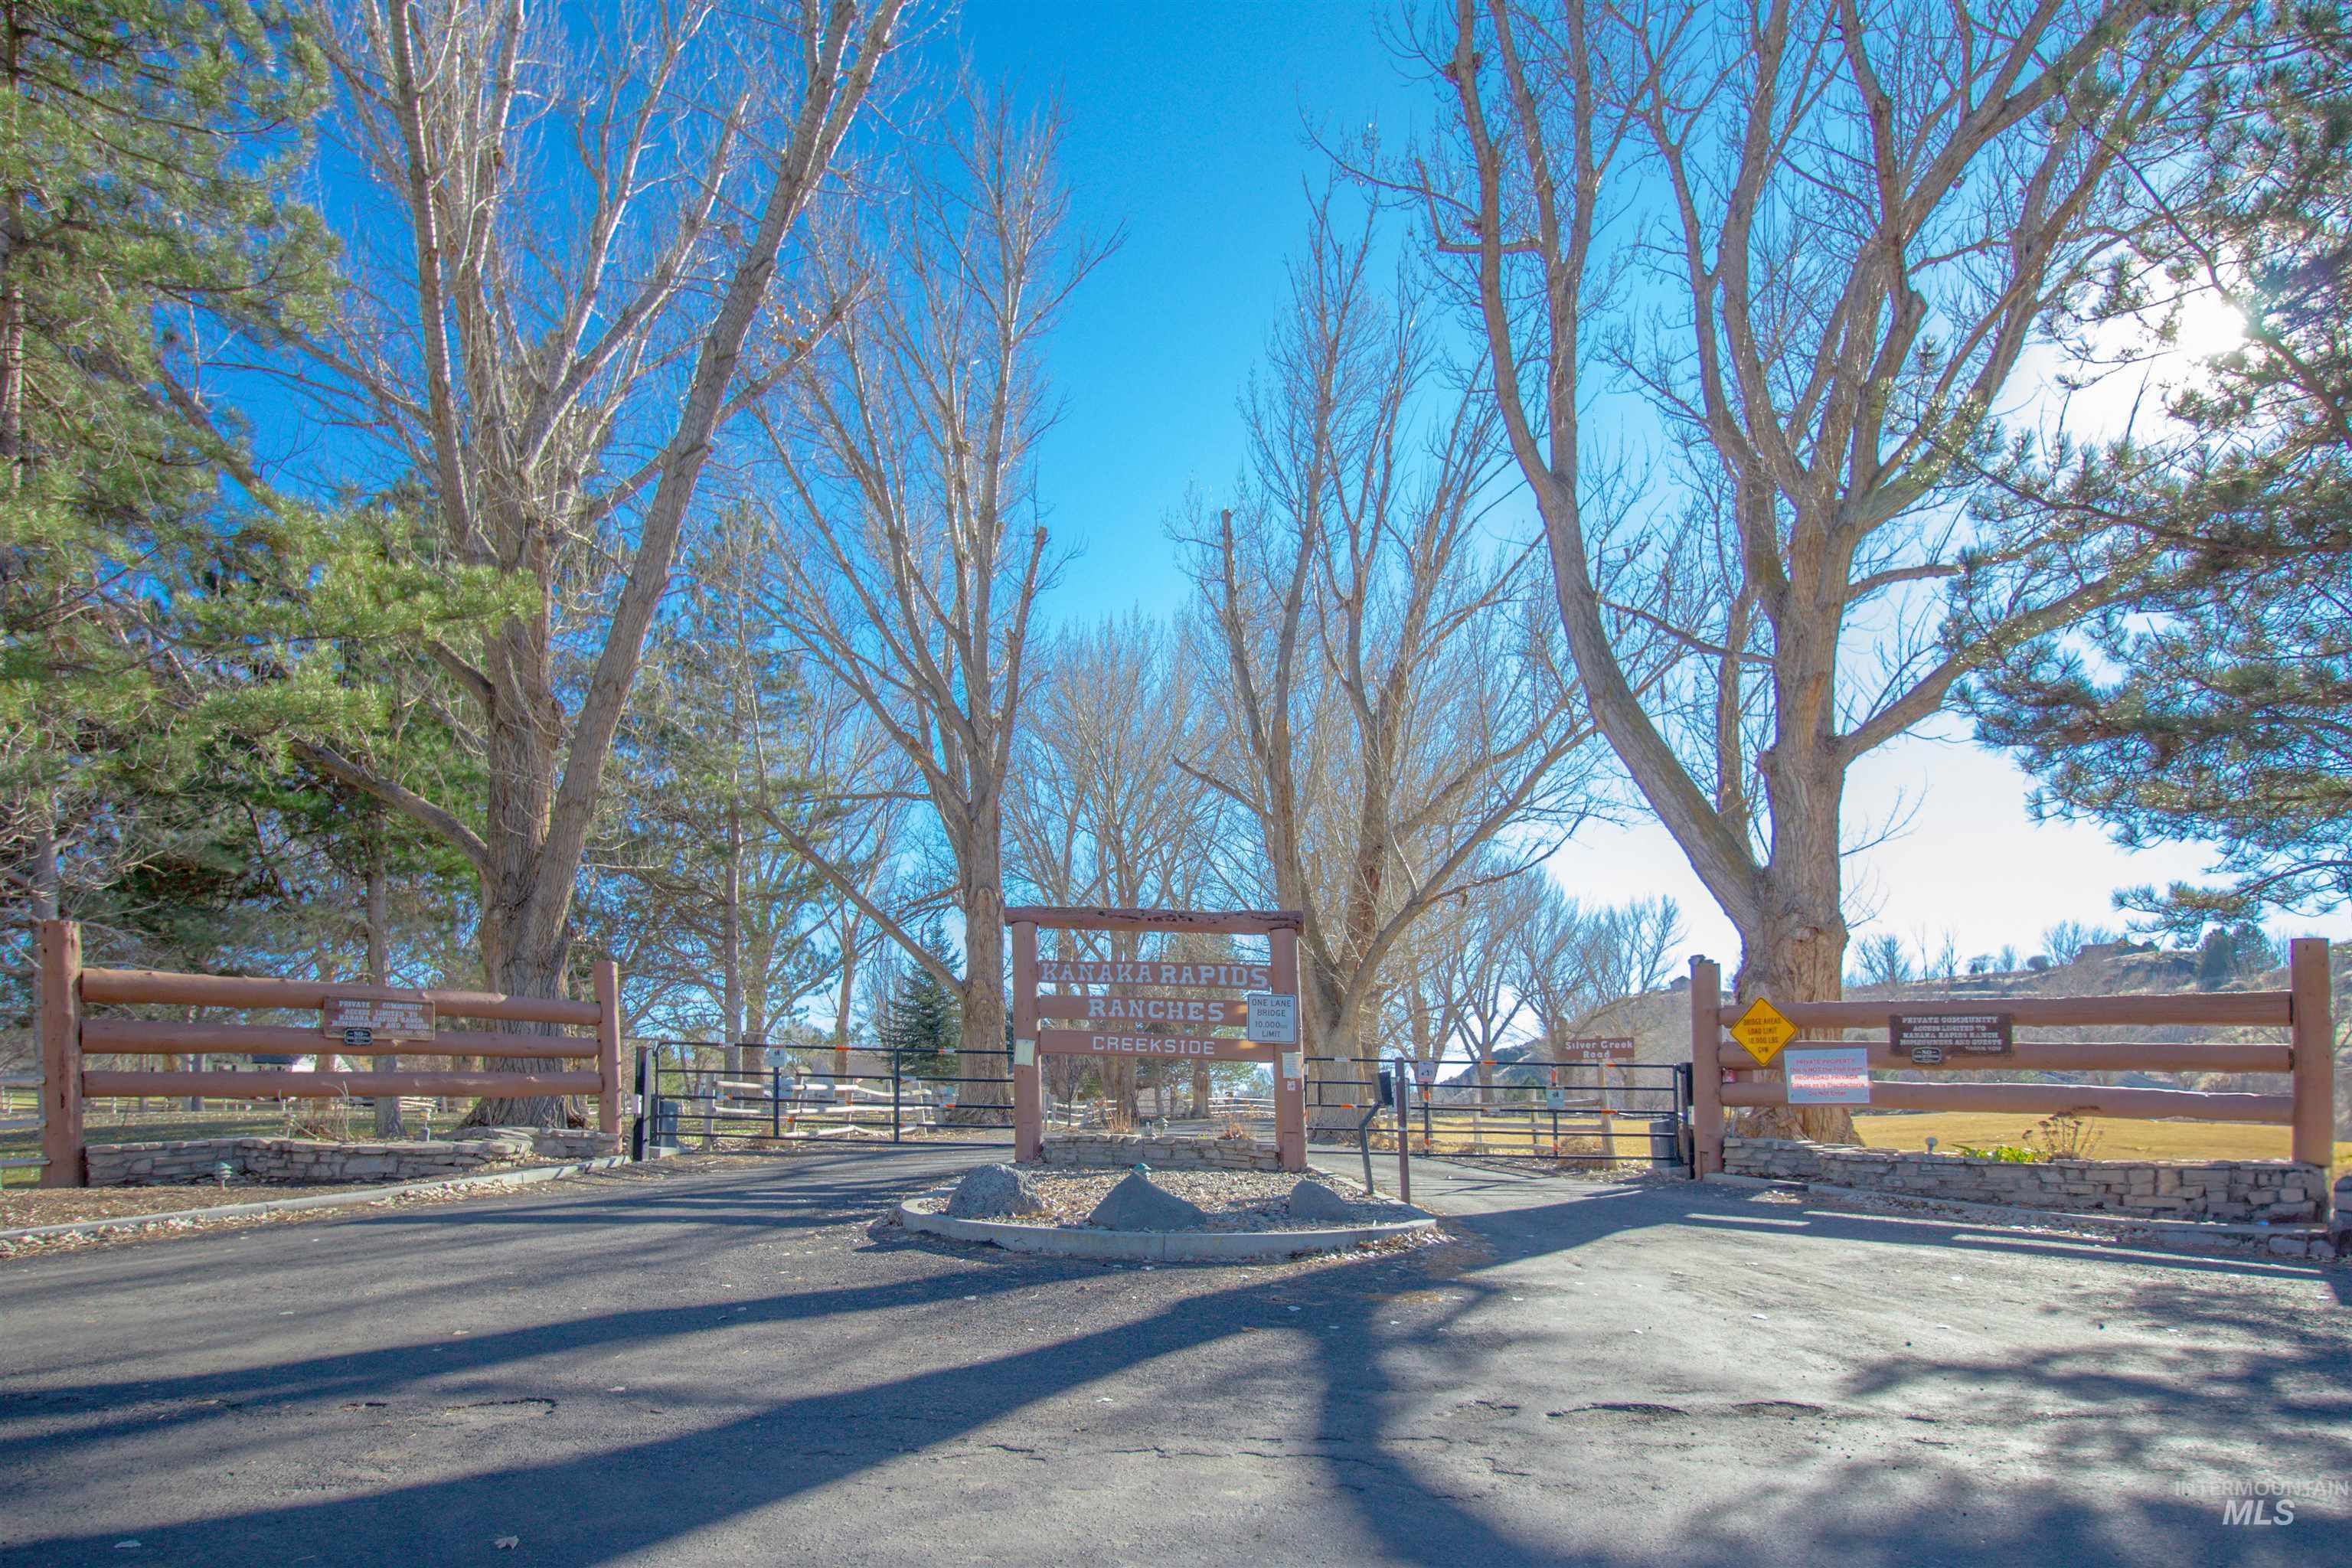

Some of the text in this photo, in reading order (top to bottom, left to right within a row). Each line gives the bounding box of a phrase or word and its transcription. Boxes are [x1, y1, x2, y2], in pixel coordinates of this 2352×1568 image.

[1041, 963, 1269, 988] KANAKA RAPIDS
[1088, 999, 1225, 1022] RANCHES
[1271, 999, 1292, 1008] LANE
[1093, 1036, 1216, 1055] CREEKSIDE
[1566, 1040, 1633, 1050] Silver Creek
[1583, 1050, 1611, 1059] Road
